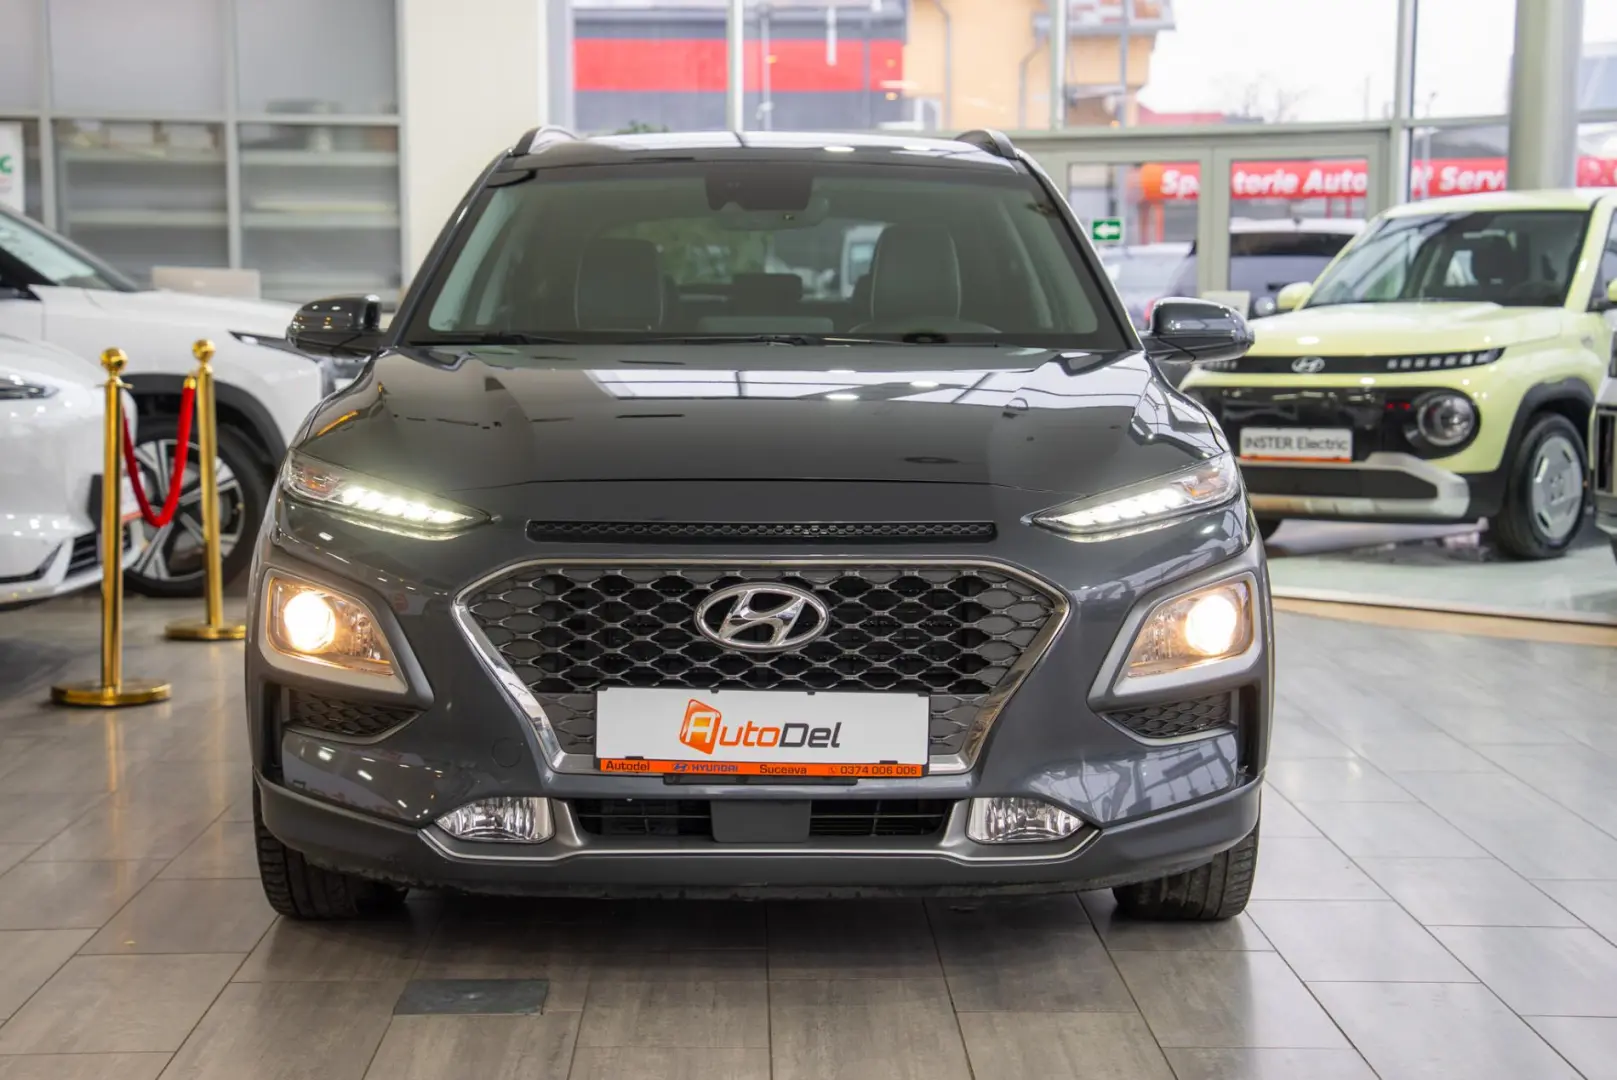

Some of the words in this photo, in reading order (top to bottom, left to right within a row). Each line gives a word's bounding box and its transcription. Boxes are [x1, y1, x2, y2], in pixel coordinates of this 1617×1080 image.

[1244, 435, 1294, 450] INSTER
[1297, 435, 1349, 451] Electric
[684, 708, 842, 748] AutoDel
[606, 760, 650, 771] Autodel
[692, 763, 738, 772] HYUNDAI
[759, 764, 807, 775] Suceava
[840, 765, 869, 775] 0374
[871, 765, 893, 775] 006
[896, 766, 917, 775] 006
